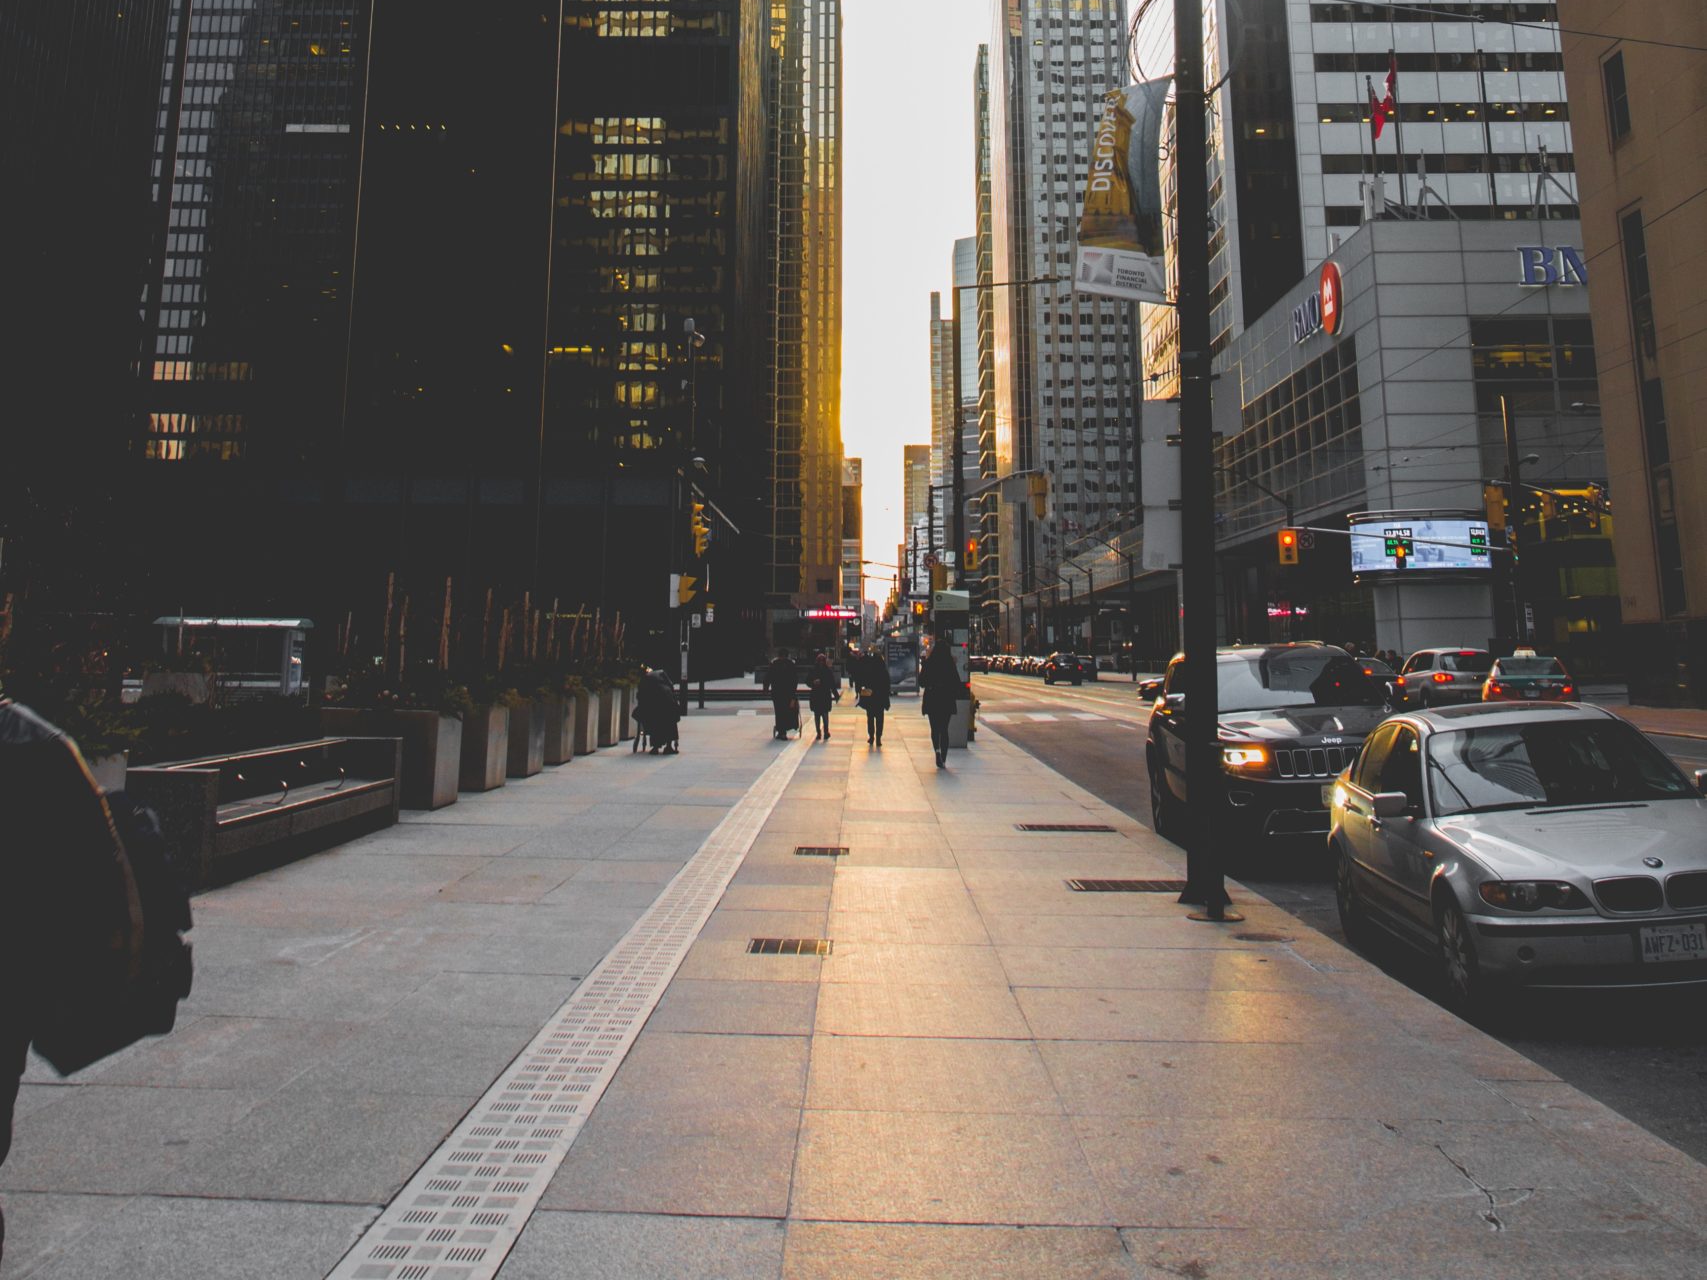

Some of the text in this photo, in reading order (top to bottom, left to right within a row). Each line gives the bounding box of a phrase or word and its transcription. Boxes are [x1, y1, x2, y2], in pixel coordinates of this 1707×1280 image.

[1091, 95, 1120, 192] DISCOVER
[1117, 268, 1145, 277] TORONTO
[1116, 275, 1147, 284] FINANCIAL
[1115, 280, 1142, 289] DISTRICT
[1292, 292, 1320, 344] BMO
[1321, 736, 1343, 744] Jeep
